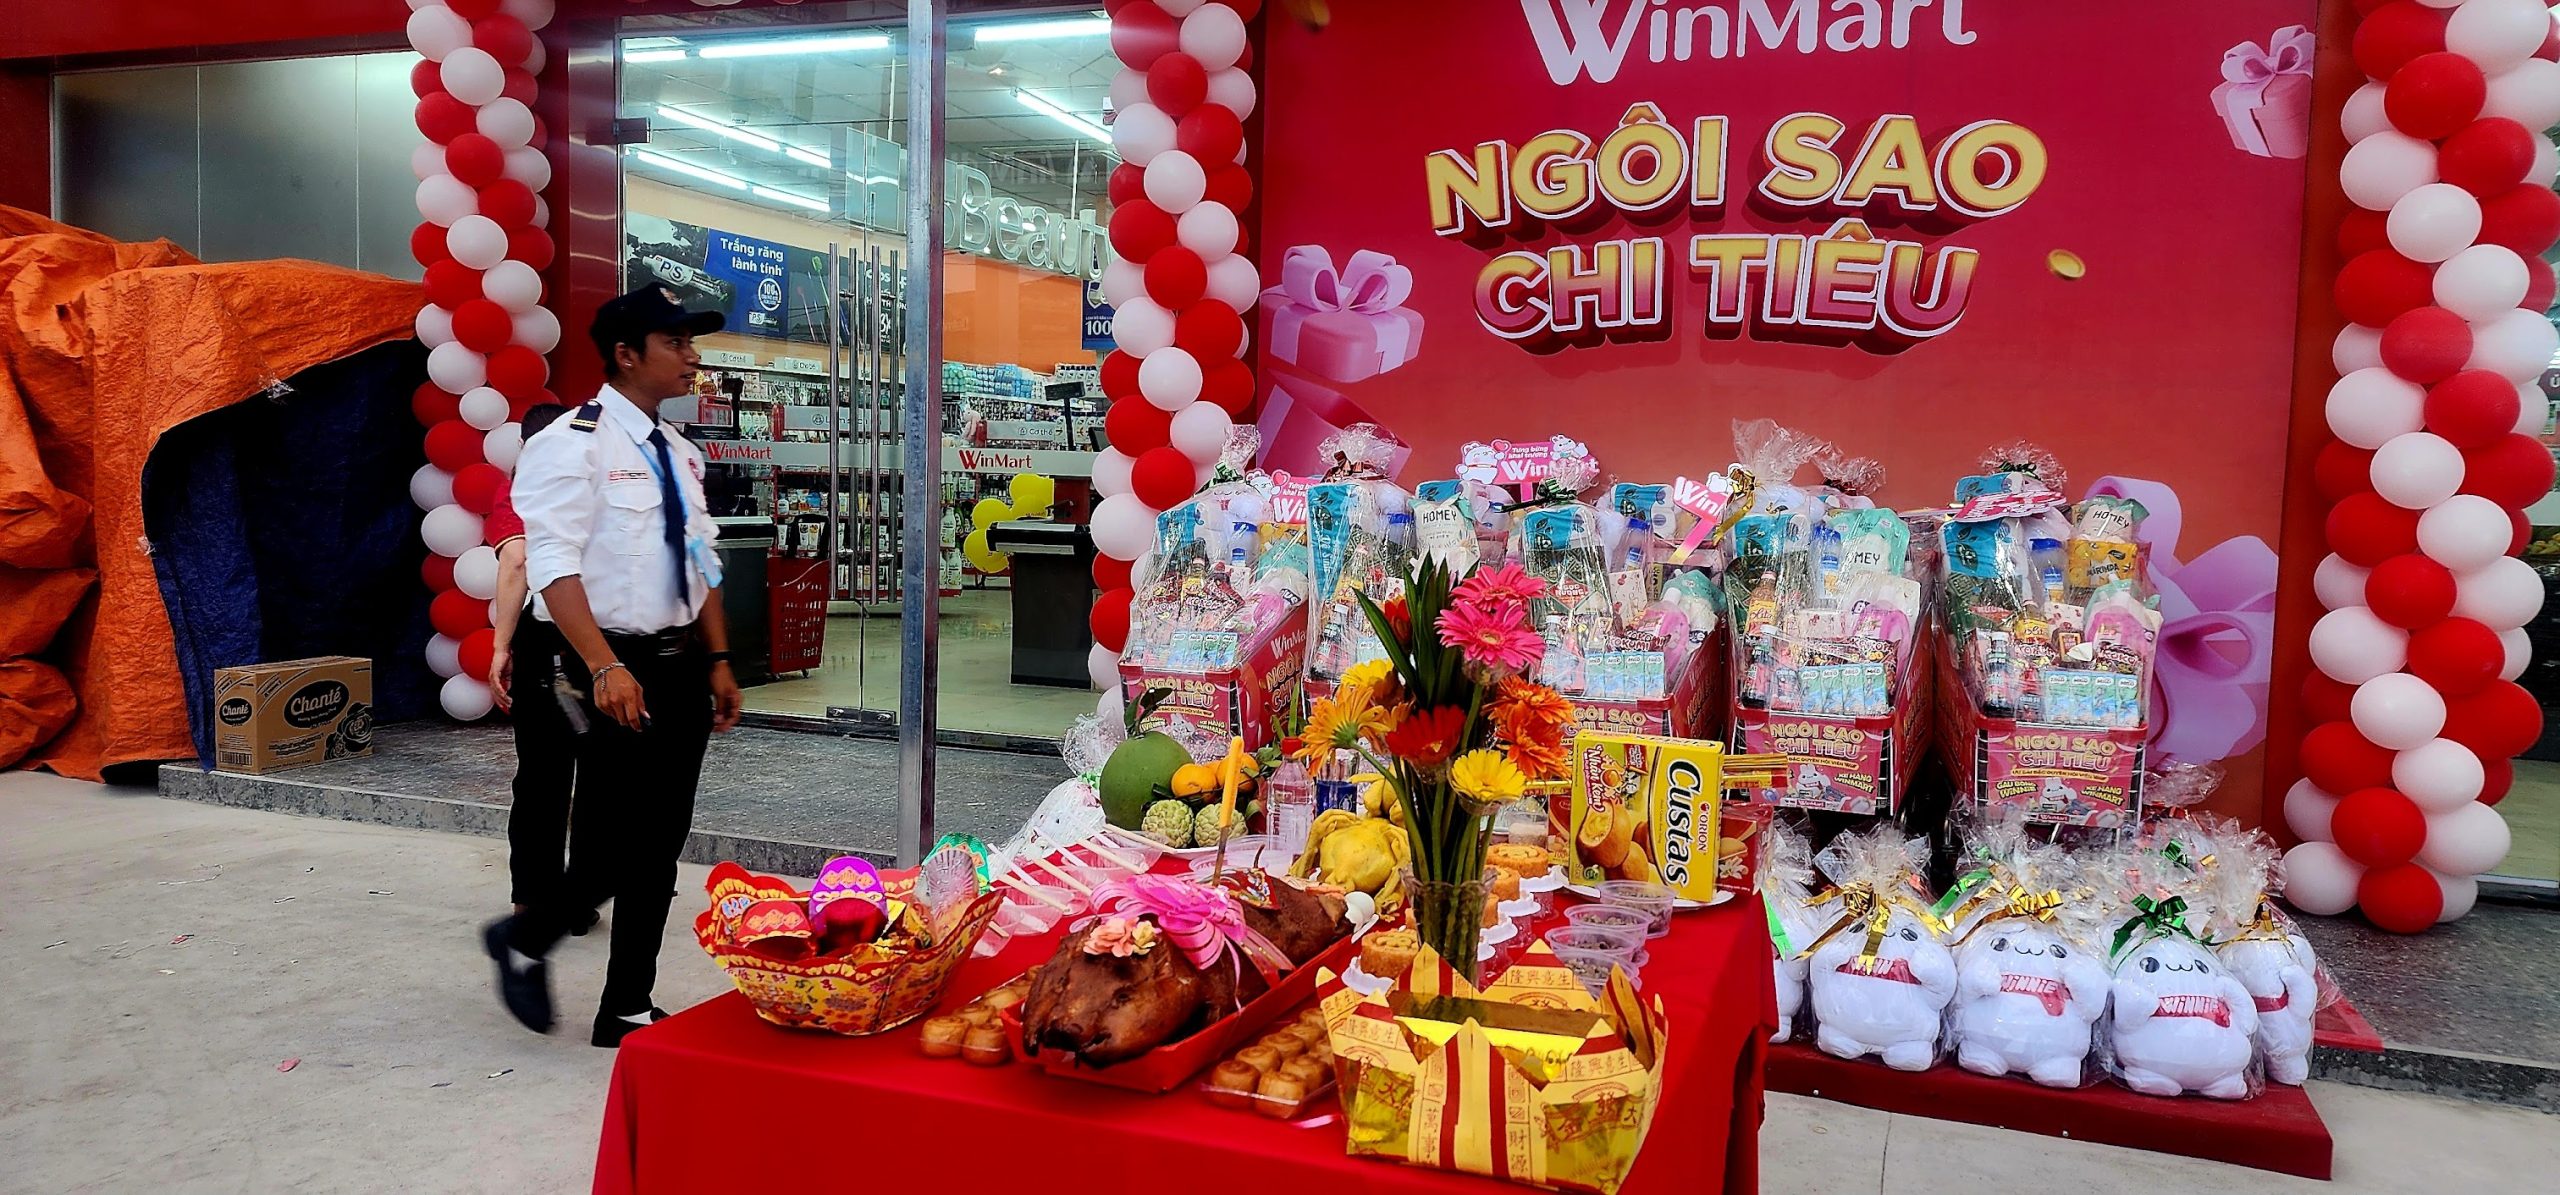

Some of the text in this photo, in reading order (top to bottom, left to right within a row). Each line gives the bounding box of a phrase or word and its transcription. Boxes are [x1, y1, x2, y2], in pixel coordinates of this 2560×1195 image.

[1520, 0, 1976, 85] WinMart
[1425, 102, 2048, 236] NGÔI SAO
[959, 164, 1113, 281] Beaut
[720, 237, 784, 262] Trắng răng
[732, 256, 757, 273] lành
[1472, 219, 1980, 340] CHI TIÊU
[705, 441, 772, 461] WinMart
[959, 450, 1032, 470] WinMart
[1423, 509, 1457, 523] HOMEY
[2093, 510, 2130, 528] HOMEY
[1184, 680, 1216, 695] SAO
[222, 703, 250, 718] Chanté
[290, 686, 342, 716] Chanté
[1607, 707, 1647, 727] SAO
[1770, 721, 1865, 745] NGÔI SAO
[2014, 732, 2117, 756] NGÔI SAO
[1774, 738, 1860, 760] CHI TIÊU
[2018, 750, 2111, 772] CHI TIÊU
[1664, 758, 1702, 888] Custas
[1697, 812, 1711, 852] ORION
